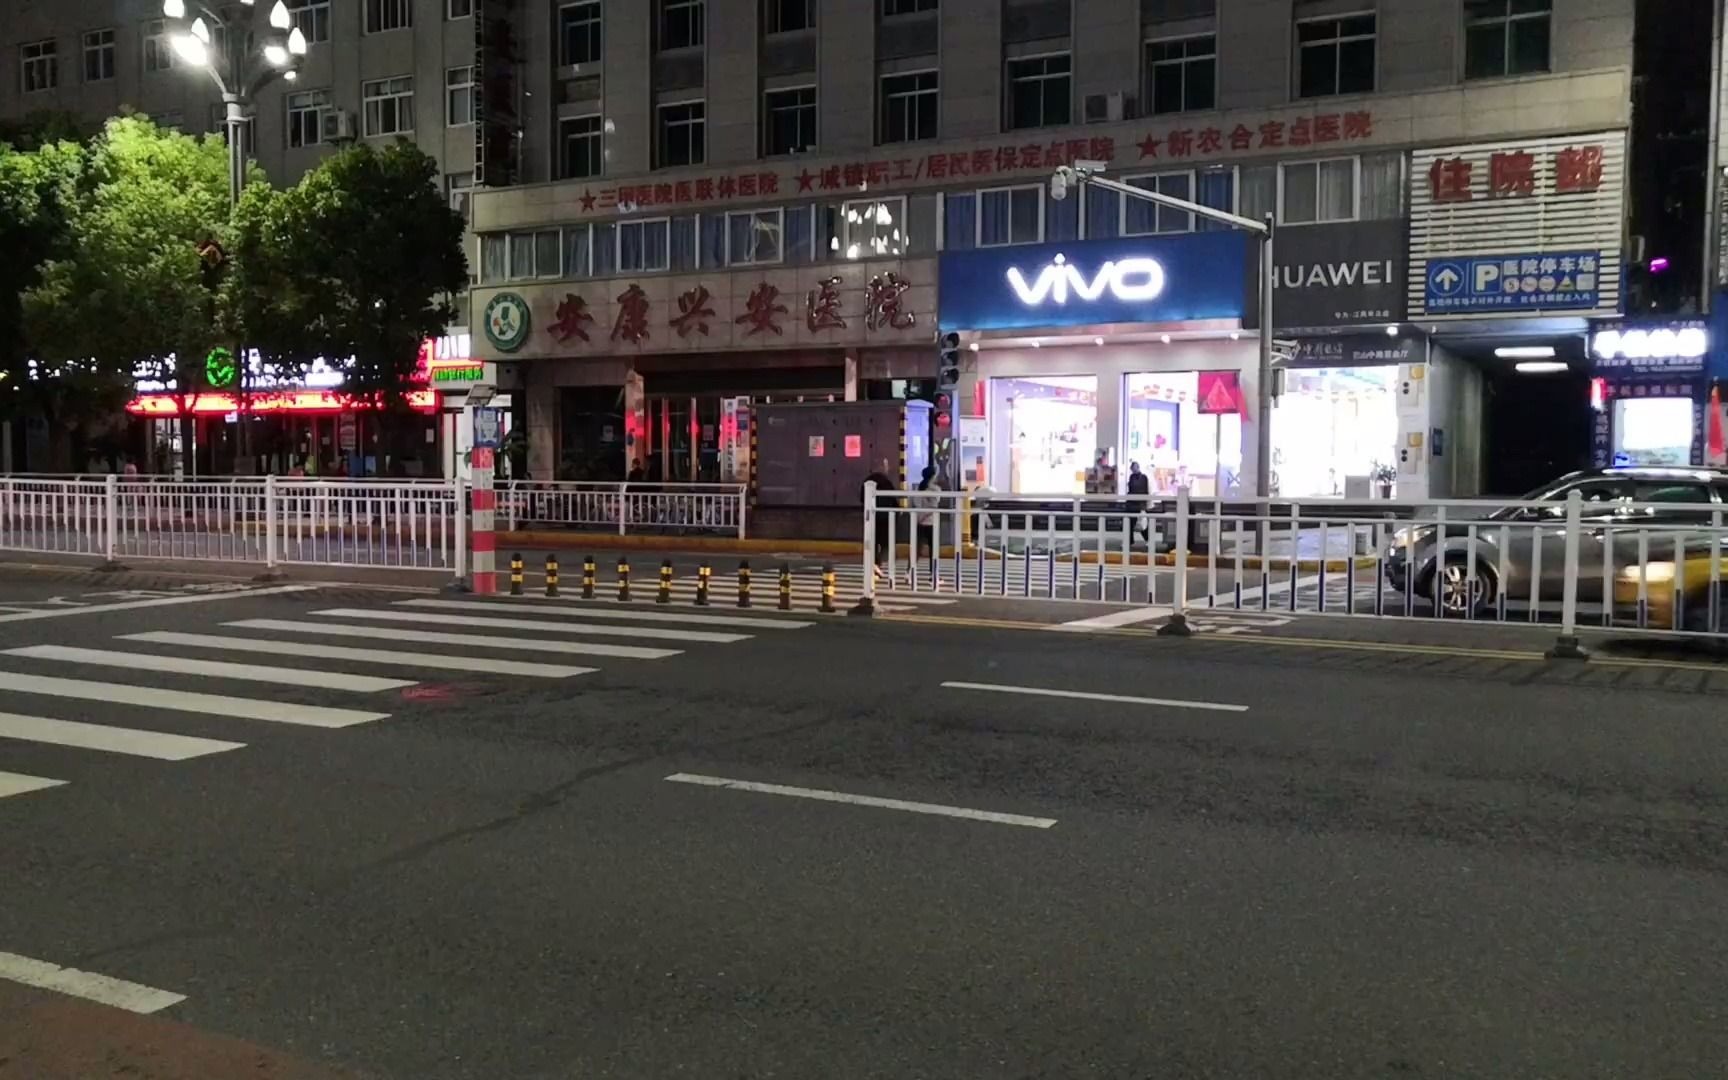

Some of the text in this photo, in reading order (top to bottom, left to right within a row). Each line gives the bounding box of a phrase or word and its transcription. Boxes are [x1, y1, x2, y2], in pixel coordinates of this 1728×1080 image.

[1167, 111, 1372, 156] 新农合定点医院
[1429, 145, 1603, 201] 住院部
[1006, 252, 1165, 306] vivo
[1475, 264, 1499, 291] P
[1503, 256, 1596, 276] 医院停车场
[546, 272, 916, 345] 安康兴安医院
